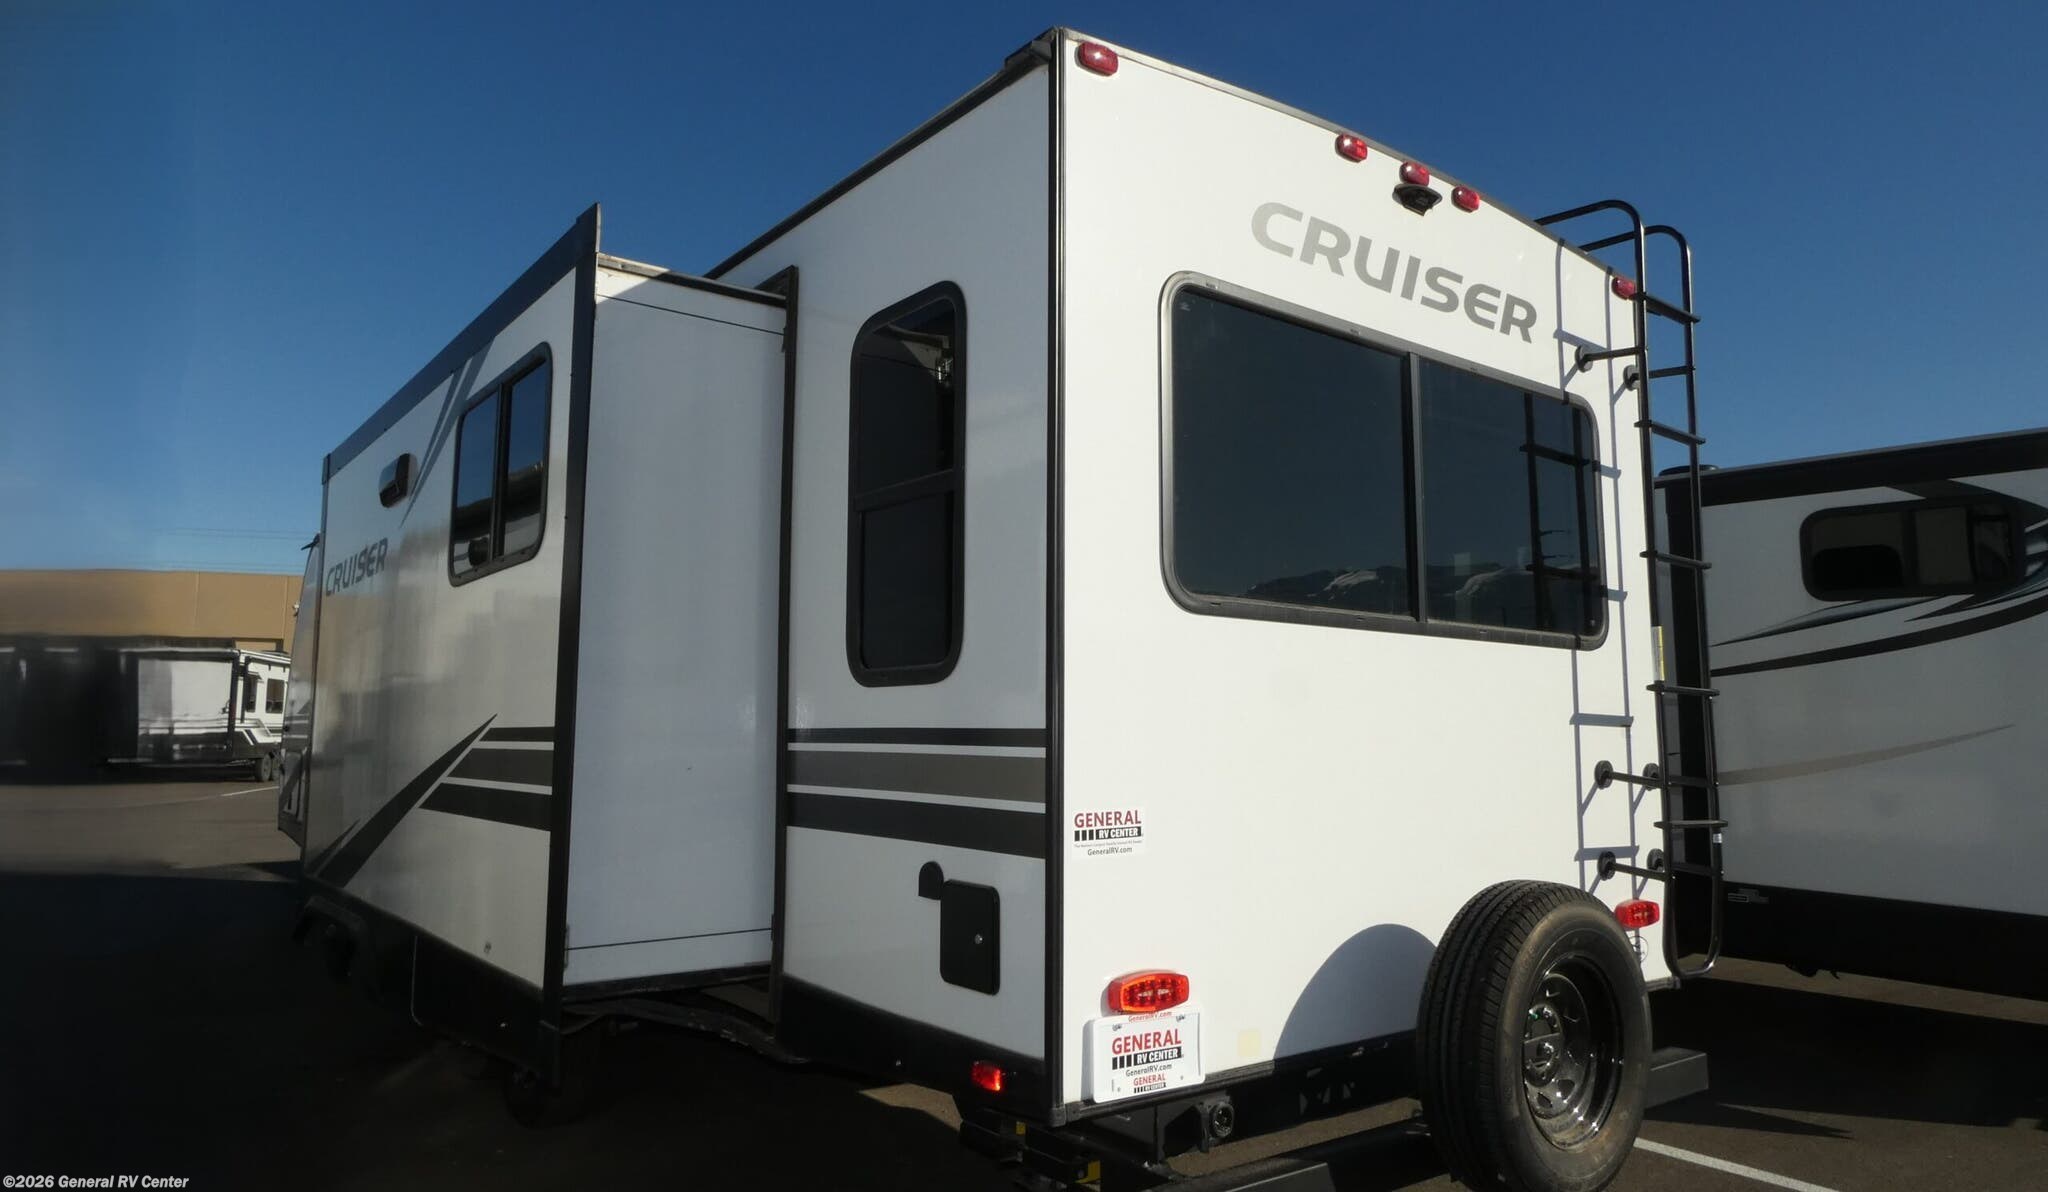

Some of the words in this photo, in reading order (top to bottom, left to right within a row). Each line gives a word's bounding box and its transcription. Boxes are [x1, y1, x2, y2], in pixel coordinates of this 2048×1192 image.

[1251, 202, 1537, 343] CRUISER
[326, 537, 388, 596] CRUISER
[1074, 810, 1142, 828] GENERAL
[1098, 829, 1110, 839] RV
[1110, 827, 1138, 838] CENTER
[1087, 846, 1133, 856] GeneralRV.com
[1112, 1028, 1182, 1055] GENERAL
[1136, 1053, 1148, 1065] RV
[1148, 1048, 1179, 1062] CENTER
[1126, 1064, 1172, 1076] GeneralRV.com
[1133, 1074, 1166, 1086] GENERAL
